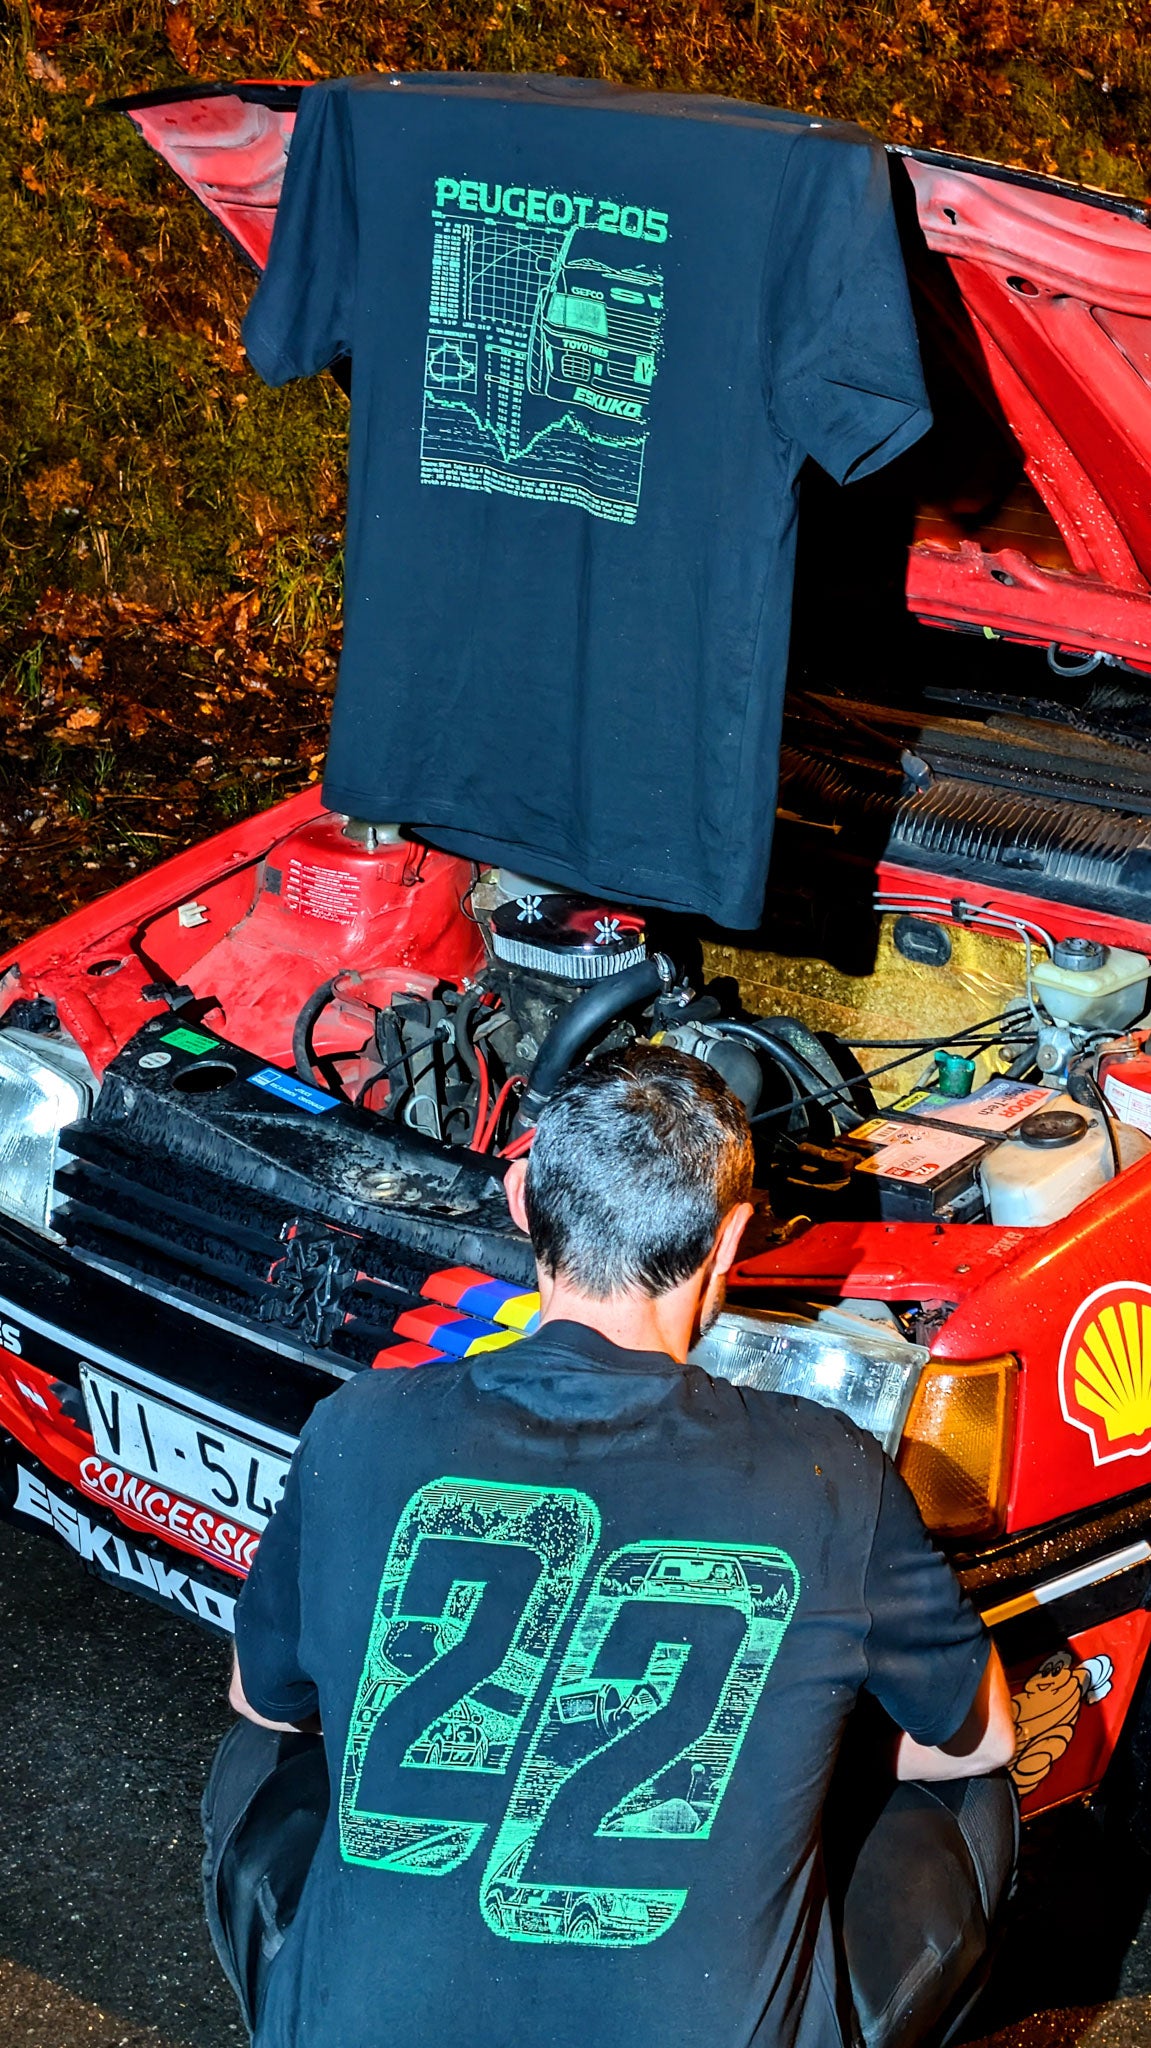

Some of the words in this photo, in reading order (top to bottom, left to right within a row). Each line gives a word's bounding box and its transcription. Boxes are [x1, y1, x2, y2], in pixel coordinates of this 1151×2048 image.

[435, 177, 593, 227] PEUGEOT
[598, 201, 669, 243] 205
[571, 286, 605, 300] GEFCO
[573, 386, 643, 418] ESKUKO
[978, 1085, 1031, 1116] High-Tech
[998, 1090, 1050, 1119] TUDOR
[0, 1320, 22, 1355] S
[89, 1379, 289, 1518] VI-54
[13, 1463, 237, 1634] ESKUKO
